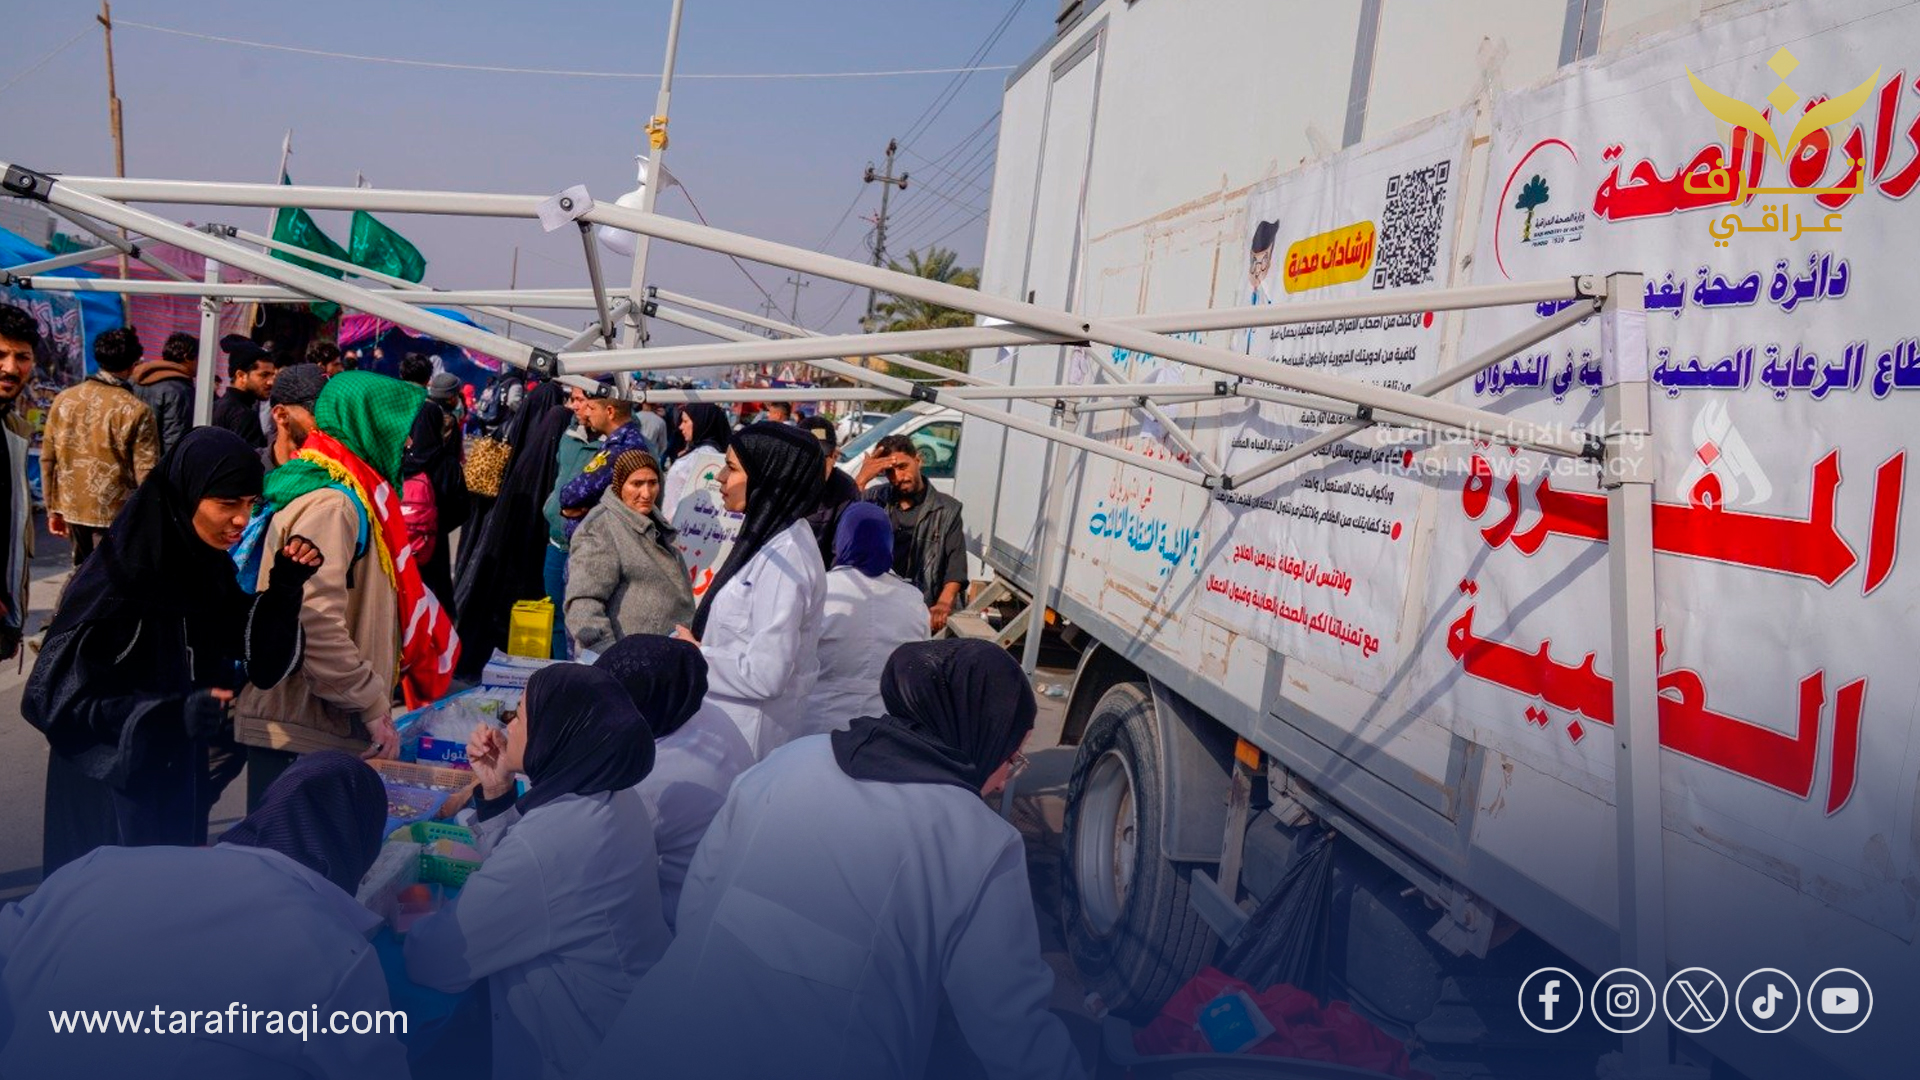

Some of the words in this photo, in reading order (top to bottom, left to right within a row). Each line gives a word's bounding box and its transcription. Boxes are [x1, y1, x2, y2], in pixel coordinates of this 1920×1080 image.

[1787, 69, 1920, 210] زارة
[1643, 270, 1687, 319] بغد
[1693, 264, 1761, 306] صحة
[1770, 253, 1849, 313] دائرة
[1552, 351, 1574, 403] في
[1652, 346, 1754, 397] الصحية
[1761, 340, 1867, 399] الرعاية
[1461, 438, 1907, 597] المفرزة
[1308, 612, 1328, 634] لكم
[1363, 634, 1380, 658] مع
